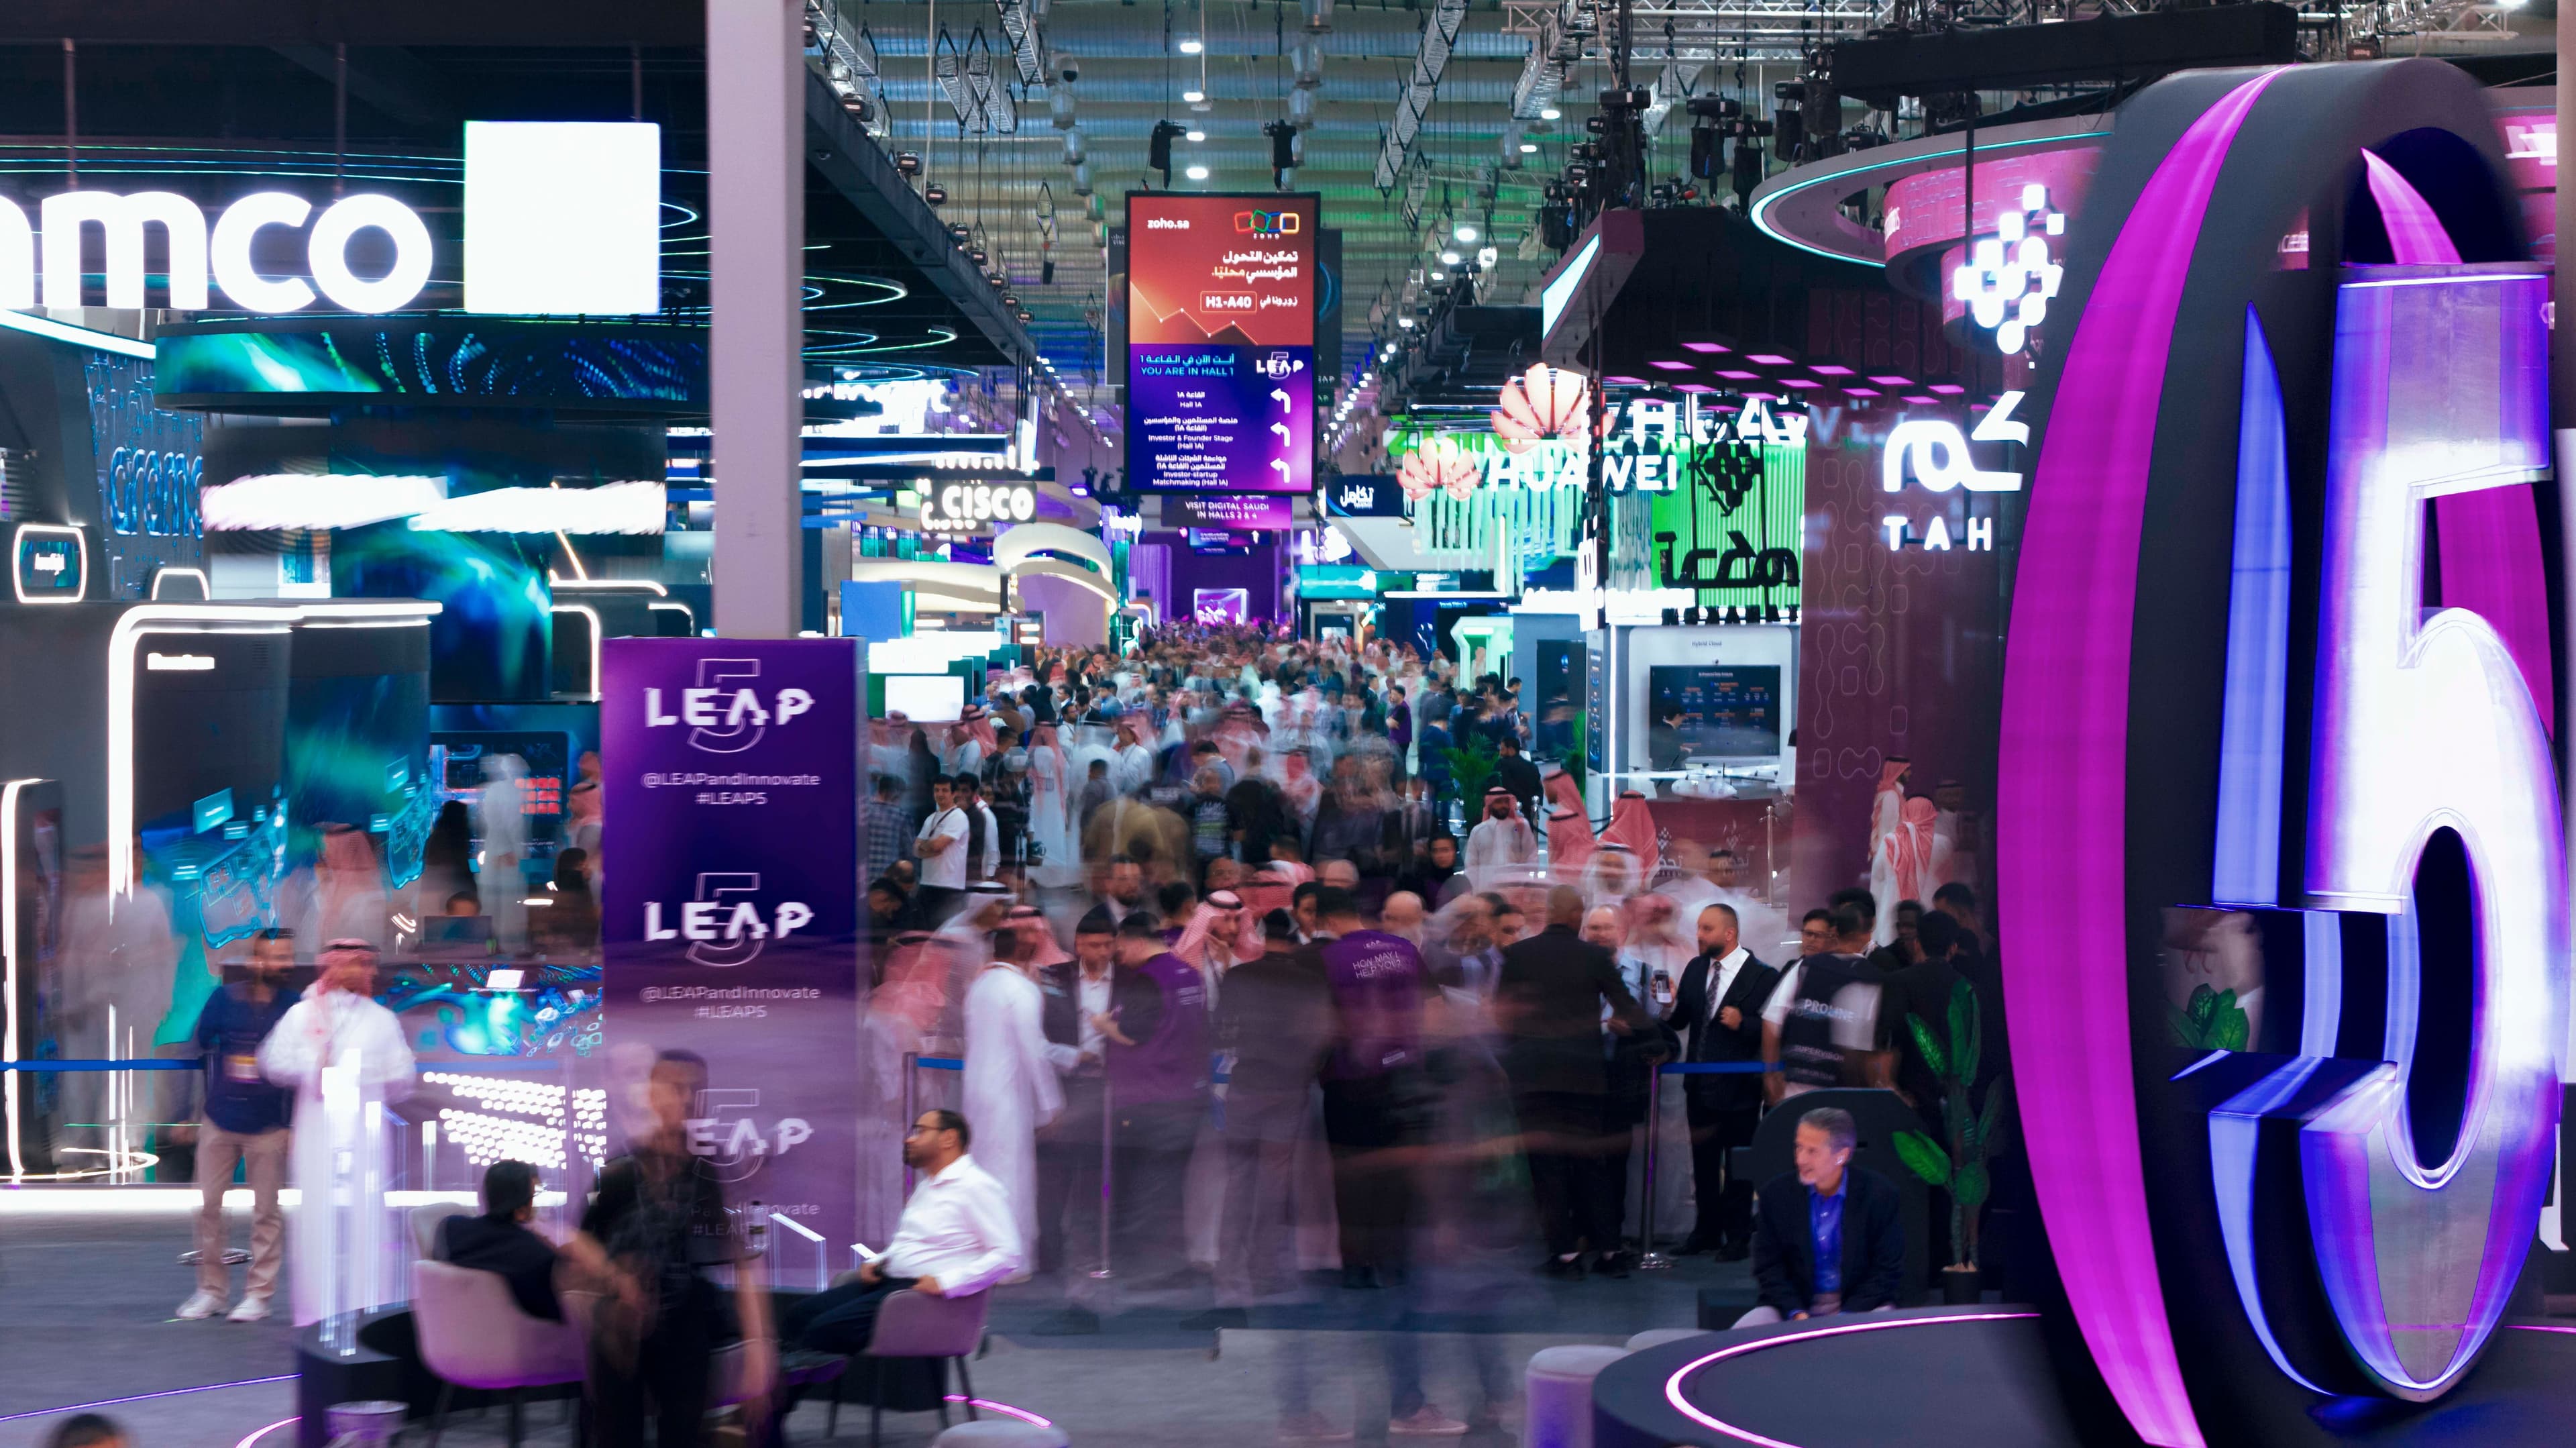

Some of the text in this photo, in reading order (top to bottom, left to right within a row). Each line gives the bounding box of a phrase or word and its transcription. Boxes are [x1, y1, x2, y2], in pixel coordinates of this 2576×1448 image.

[1147, 217, 1190, 229] zoho.sa
[1223, 250, 1299, 264] تمكين التحول
[1246, 265, 1298, 285] المؤسسي
[1205, 295, 1252, 309] H1-A40
[1260, 295, 1298, 310] زورونا في
[1182, 354, 1194, 367] في
[1256, 359, 1305, 374] LEAP
[1141, 366, 1162, 376] YOU
[1165, 366, 1185, 376] ARE
[1188, 366, 1199, 376] IN
[1201, 367, 1228, 377] HALL
[1186, 391, 1205, 399] القاعة
[1180, 401, 1203, 409] Hall 1A
[1148, 434, 1176, 443] Investor
[1183, 434, 1212, 443] Founder
[1214, 434, 1234, 444] Stage
[1177, 442, 1205, 451] (Hall 1A)
[1152, 478, 1229, 487] Matchmaking (Hall 1A)
[942, 484, 1034, 521] CISCO
[1185, 501, 1270, 511] VISIT DIGITAL SAUDI
[1197, 510, 1206, 520] IN
[1208, 511, 1236, 520] HALLS
[1882, 515, 1992, 552] TAH
[644, 686, 815, 727] LEAP
[687, 658, 769, 753] 5
[640, 772, 822, 788] @LEAPandInnovate
[695, 791, 769, 805] #LEAP5
[643, 900, 815, 941] LEAP
[686, 872, 769, 968] 5
[1352, 958, 1373, 970] HOW
[1375, 951, 1393, 962] MAY
[1355, 965, 1377, 979] HELP
[639, 986, 822, 1003] @LEAPandInnovate
[693, 1005, 769, 1019] #LEAP5
[681, 1117, 815, 1156] EAP
